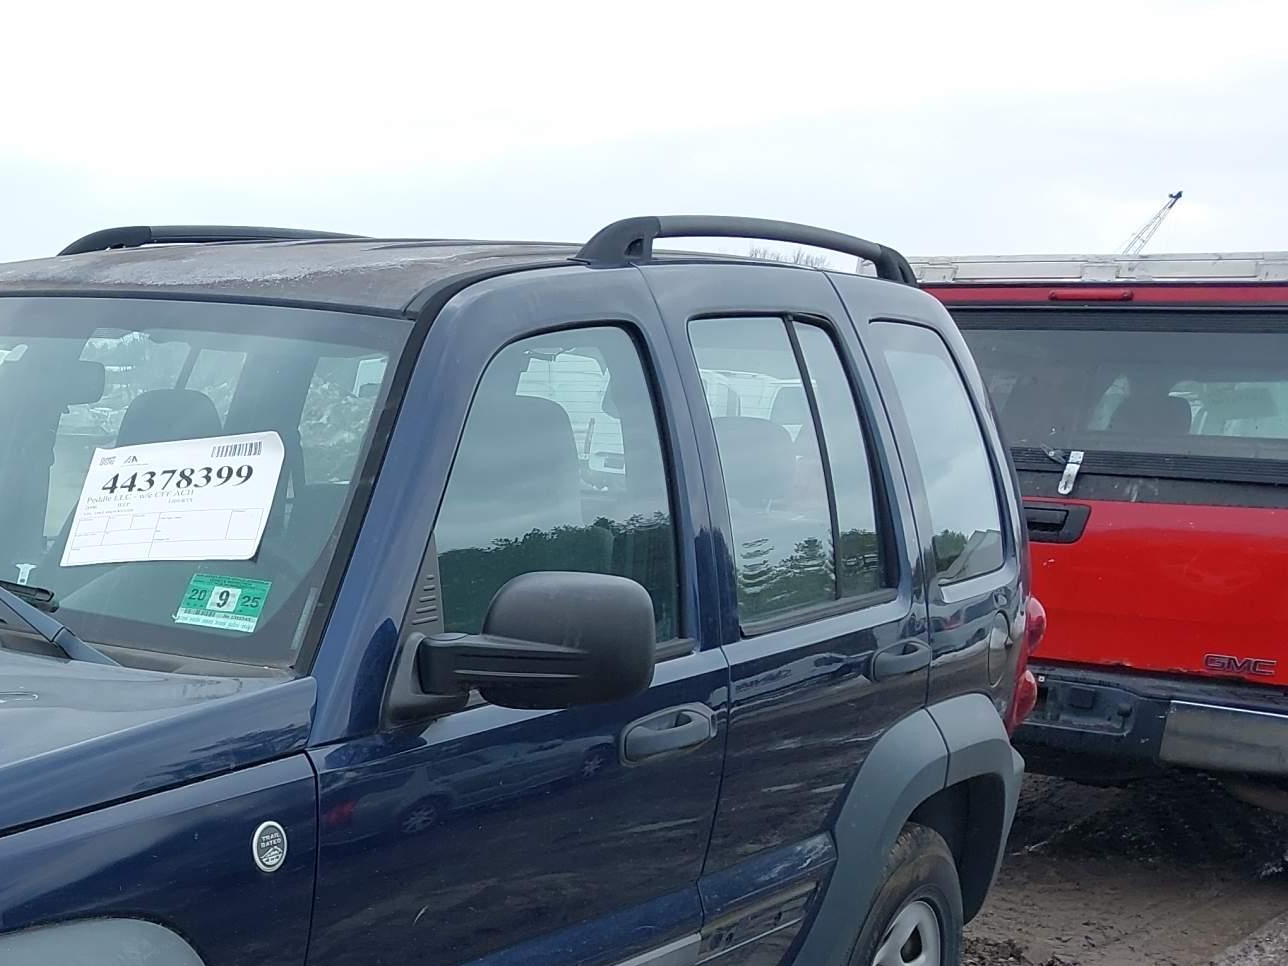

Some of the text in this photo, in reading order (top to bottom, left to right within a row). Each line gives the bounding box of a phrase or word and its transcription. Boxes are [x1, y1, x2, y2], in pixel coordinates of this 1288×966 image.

[101, 464, 254, 494] 44378399
[188, 588, 261, 608] 20 9 25
[1203, 653, 1278, 676] GMC
